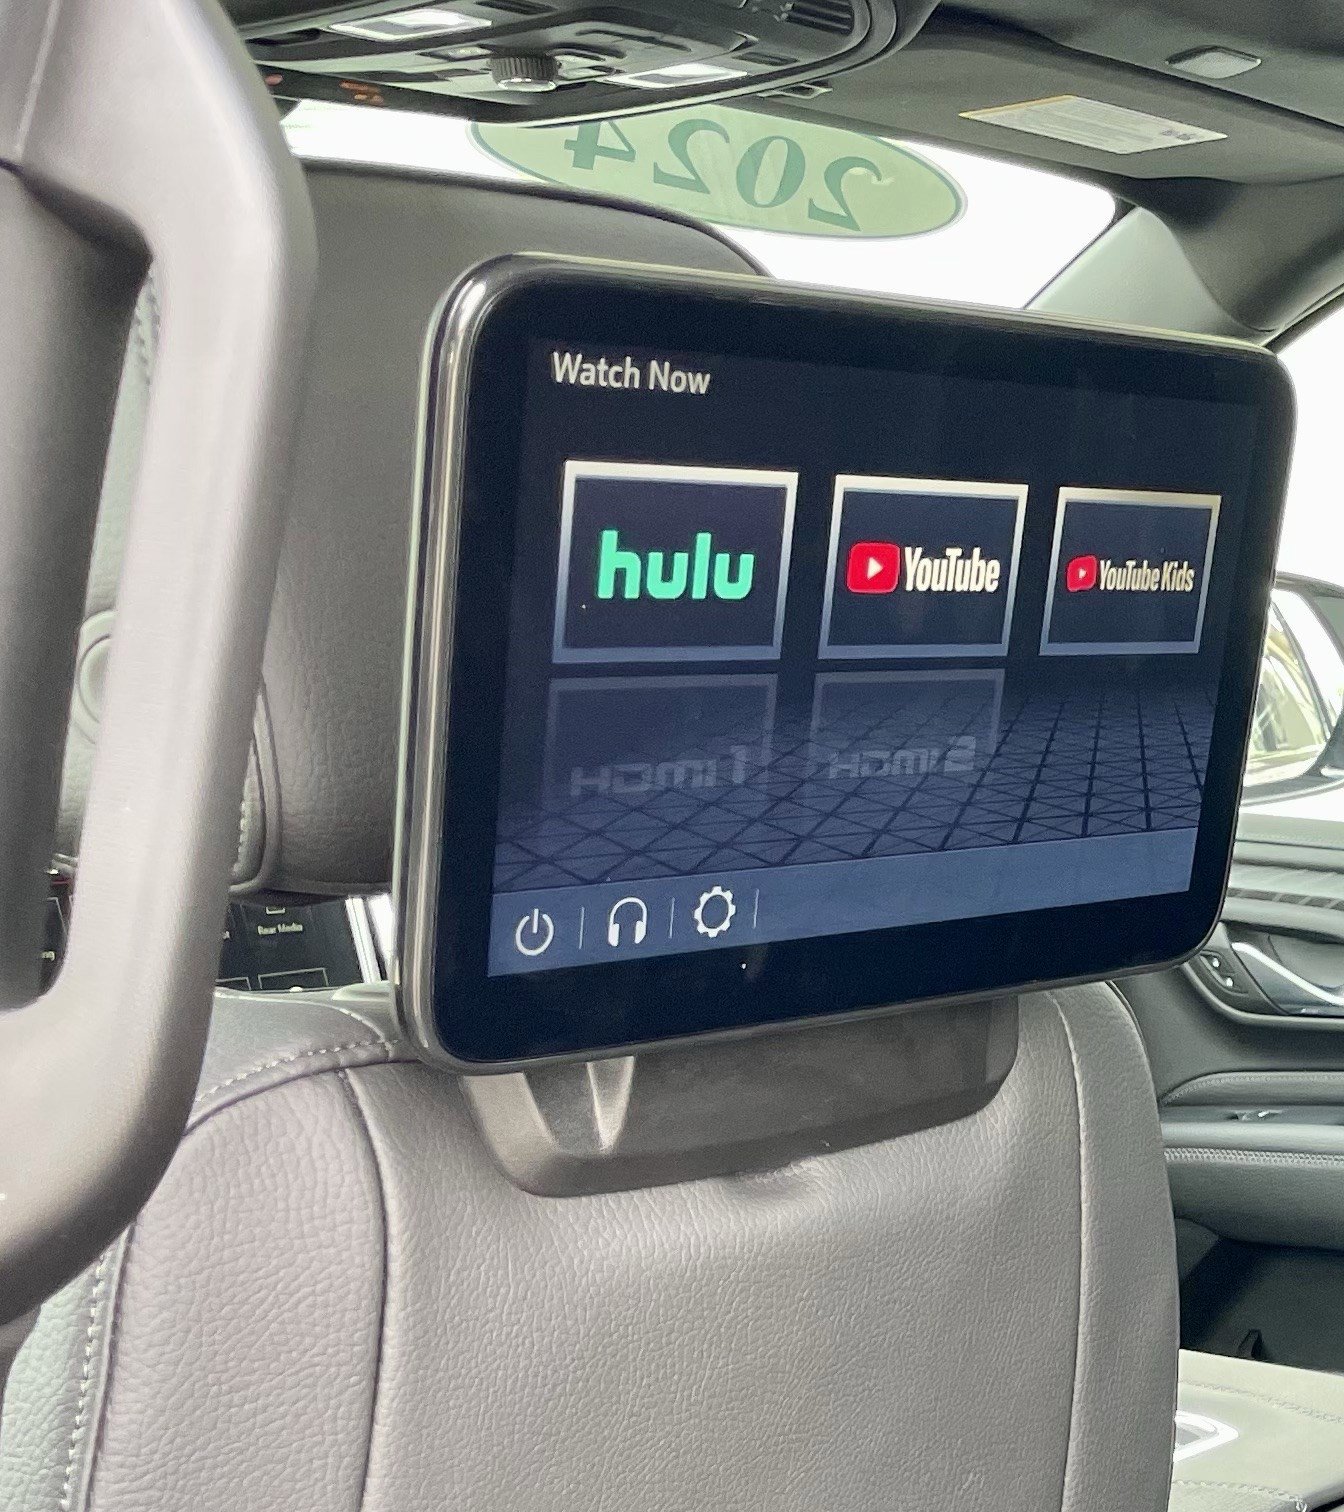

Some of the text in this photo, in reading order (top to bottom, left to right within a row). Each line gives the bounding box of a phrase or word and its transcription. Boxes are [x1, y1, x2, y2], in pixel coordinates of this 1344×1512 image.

[552, 351, 711, 395] Watch Now
[597, 529, 755, 600] hulu
[904, 546, 1001, 593] YouTube
[1099, 559, 1196, 593] YouTube Kids
